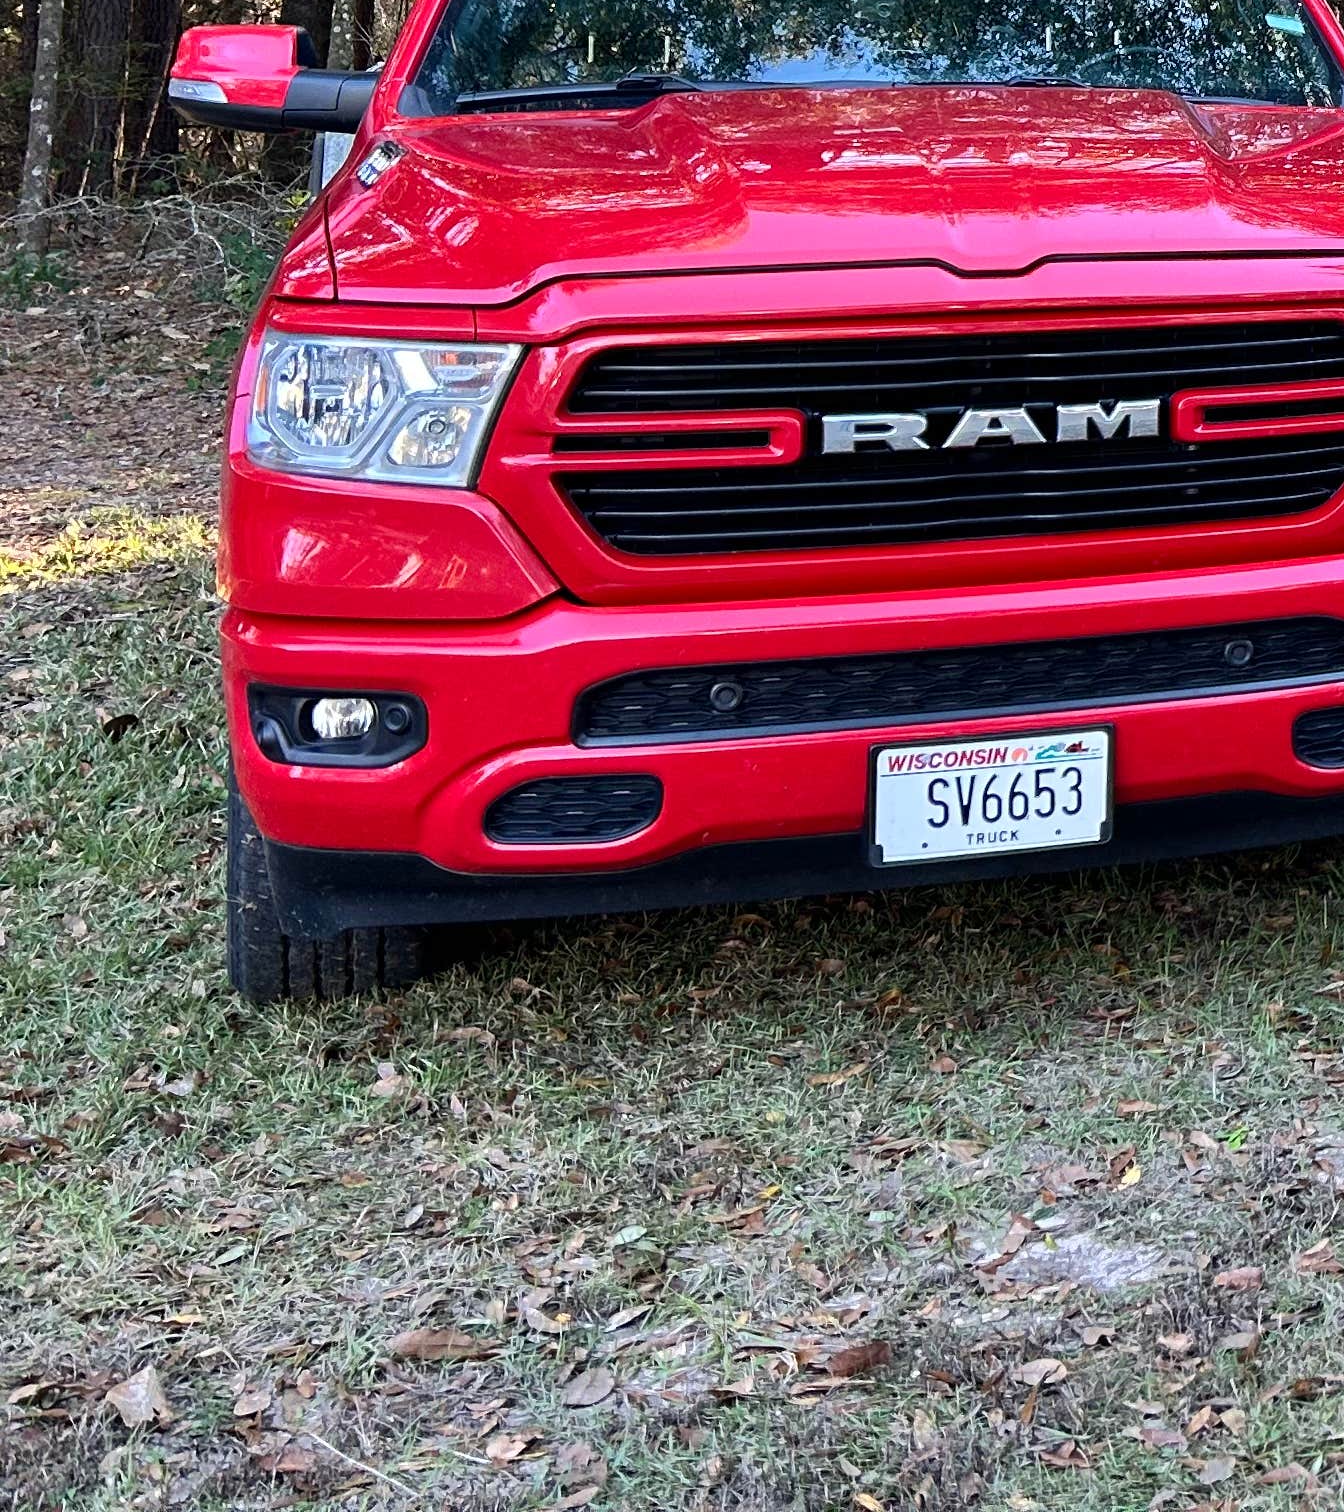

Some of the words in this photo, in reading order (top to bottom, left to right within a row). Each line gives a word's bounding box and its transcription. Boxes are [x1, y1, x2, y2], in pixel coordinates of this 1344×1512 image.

[822, 398, 1160, 455] RAM
[887, 746, 1009, 773] WISCONSIN
[927, 766, 1083, 829] SV6653
[966, 830, 1020, 846] TRUCK
